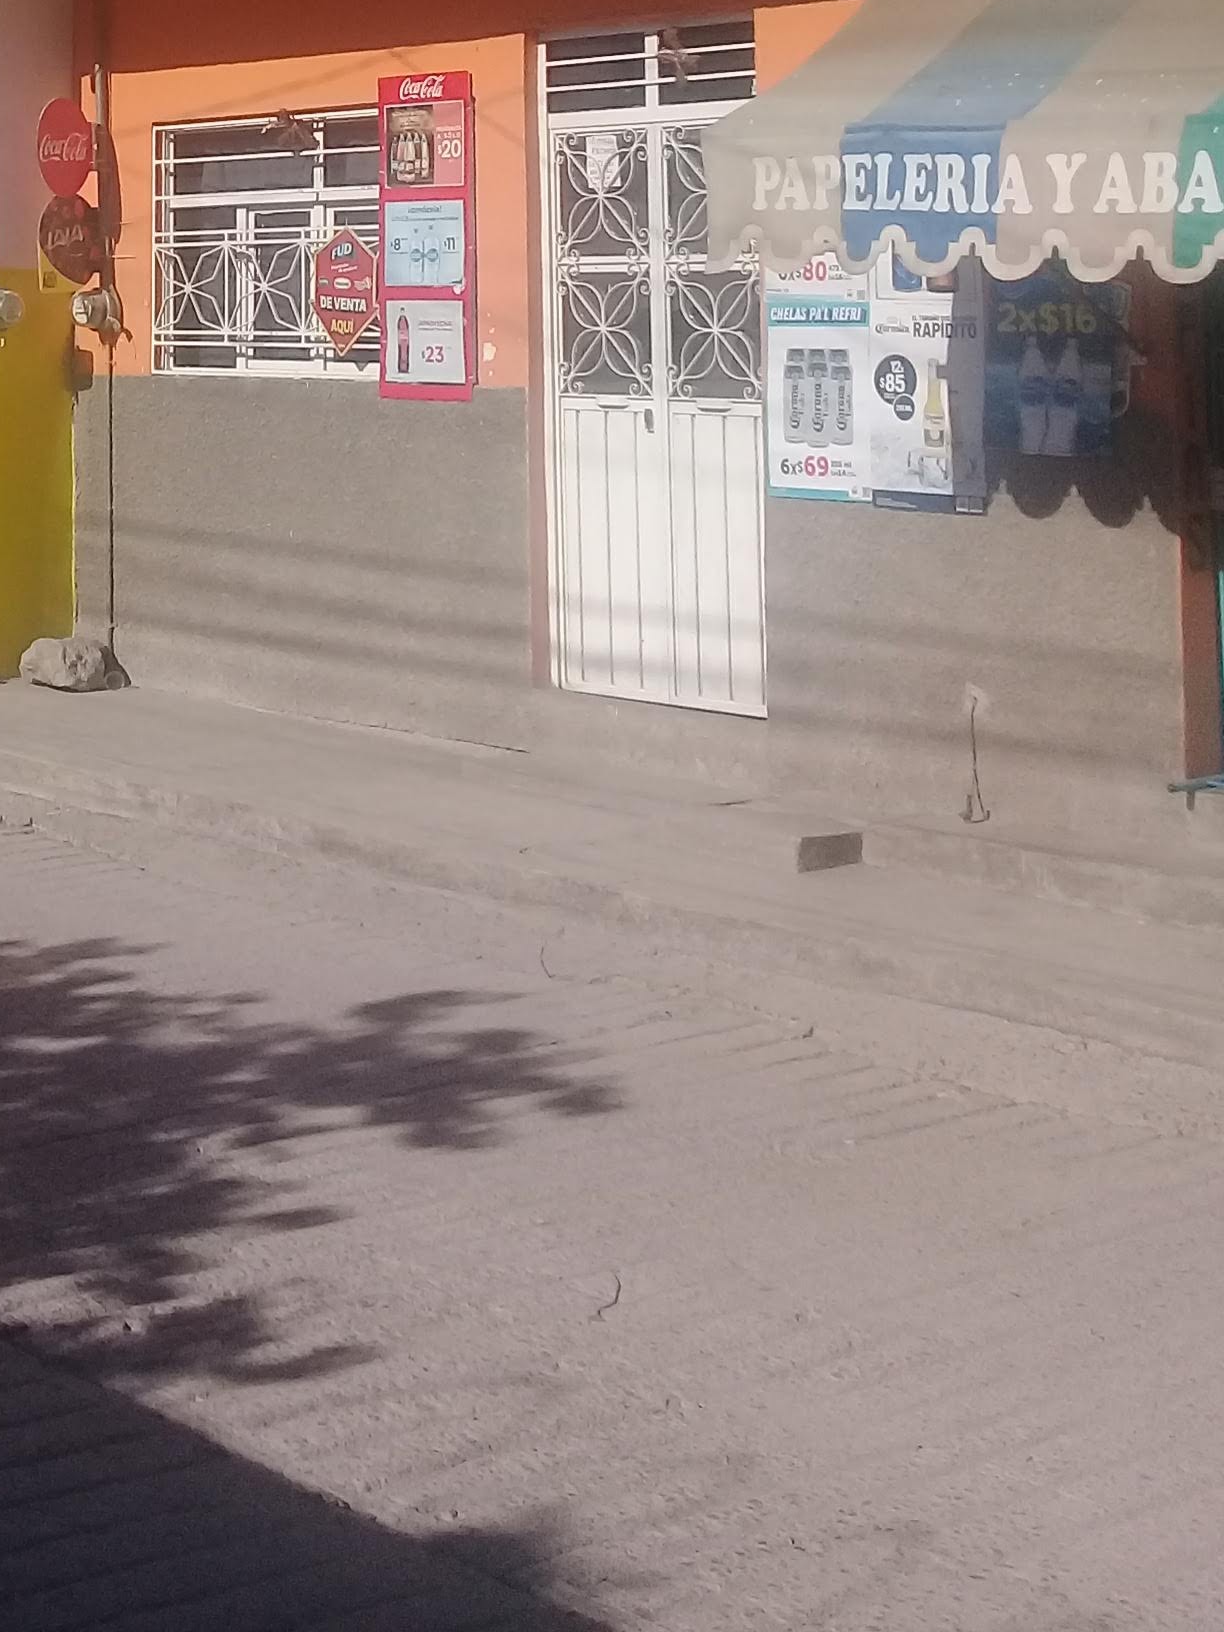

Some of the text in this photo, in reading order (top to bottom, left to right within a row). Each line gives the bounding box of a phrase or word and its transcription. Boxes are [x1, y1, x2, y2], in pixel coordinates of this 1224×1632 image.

[437, 139, 462, 158] $20
[752, 150, 1224, 215] PAPELERIA Y ABA
[331, 242, 353, 260] FUD
[319, 295, 367, 313] DE VENTA
[770, 306, 807, 321] CHELAS
[831, 306, 861, 321] REFRI
[879, 373, 906, 393] $85
